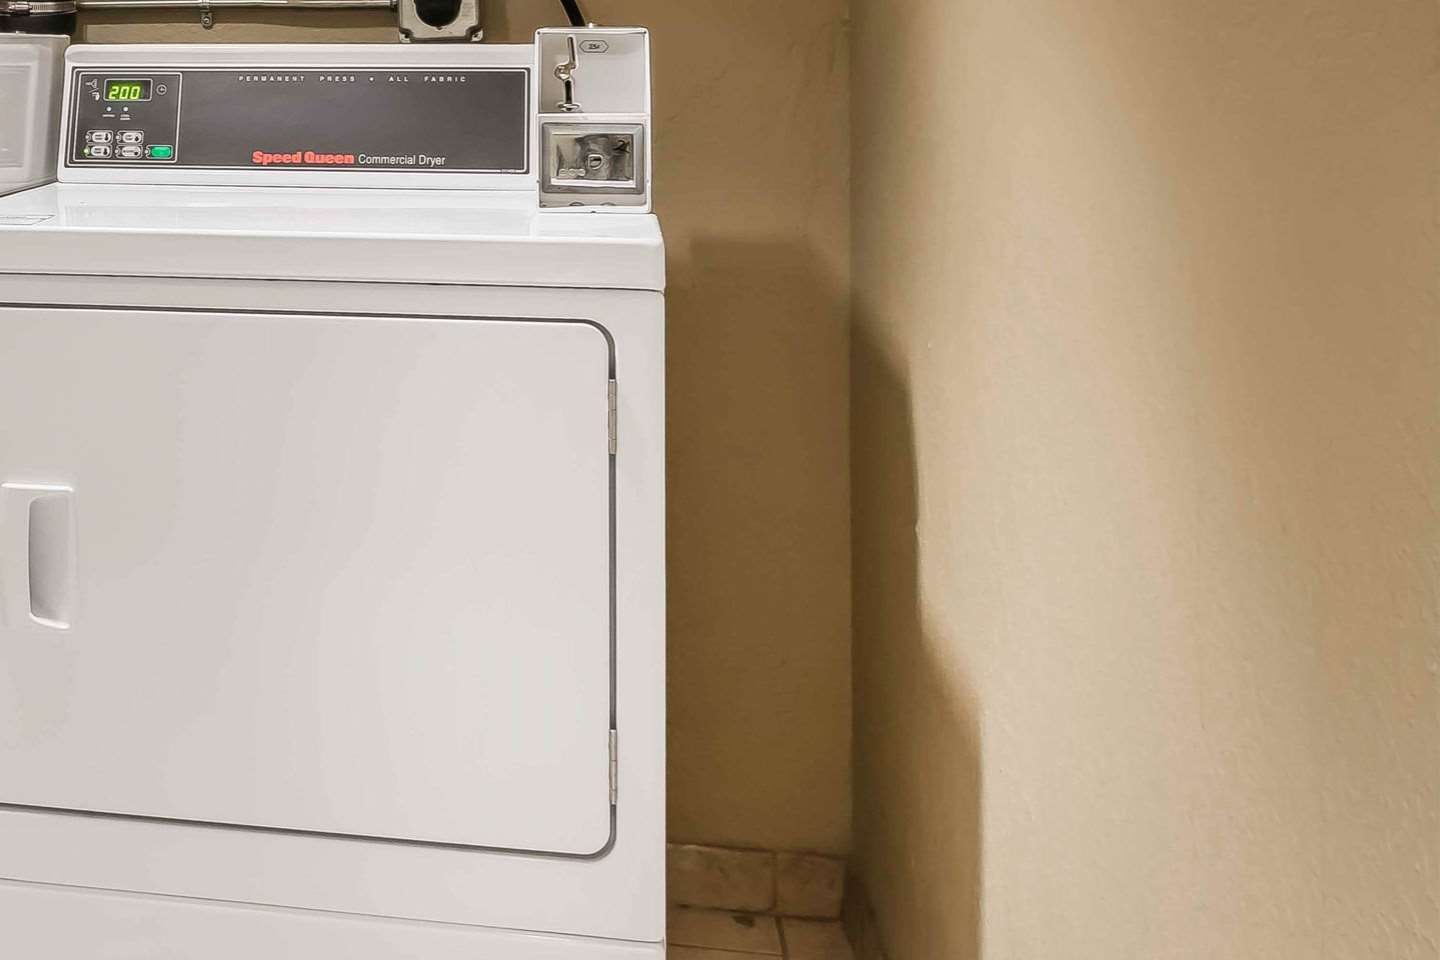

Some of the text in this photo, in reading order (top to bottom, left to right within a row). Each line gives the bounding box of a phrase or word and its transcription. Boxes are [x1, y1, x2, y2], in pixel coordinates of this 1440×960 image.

[423, 75, 467, 83] FABRIC
[108, 85, 141, 100] 200
[252, 151, 446, 168] Speed Queen Commercial Dryer
